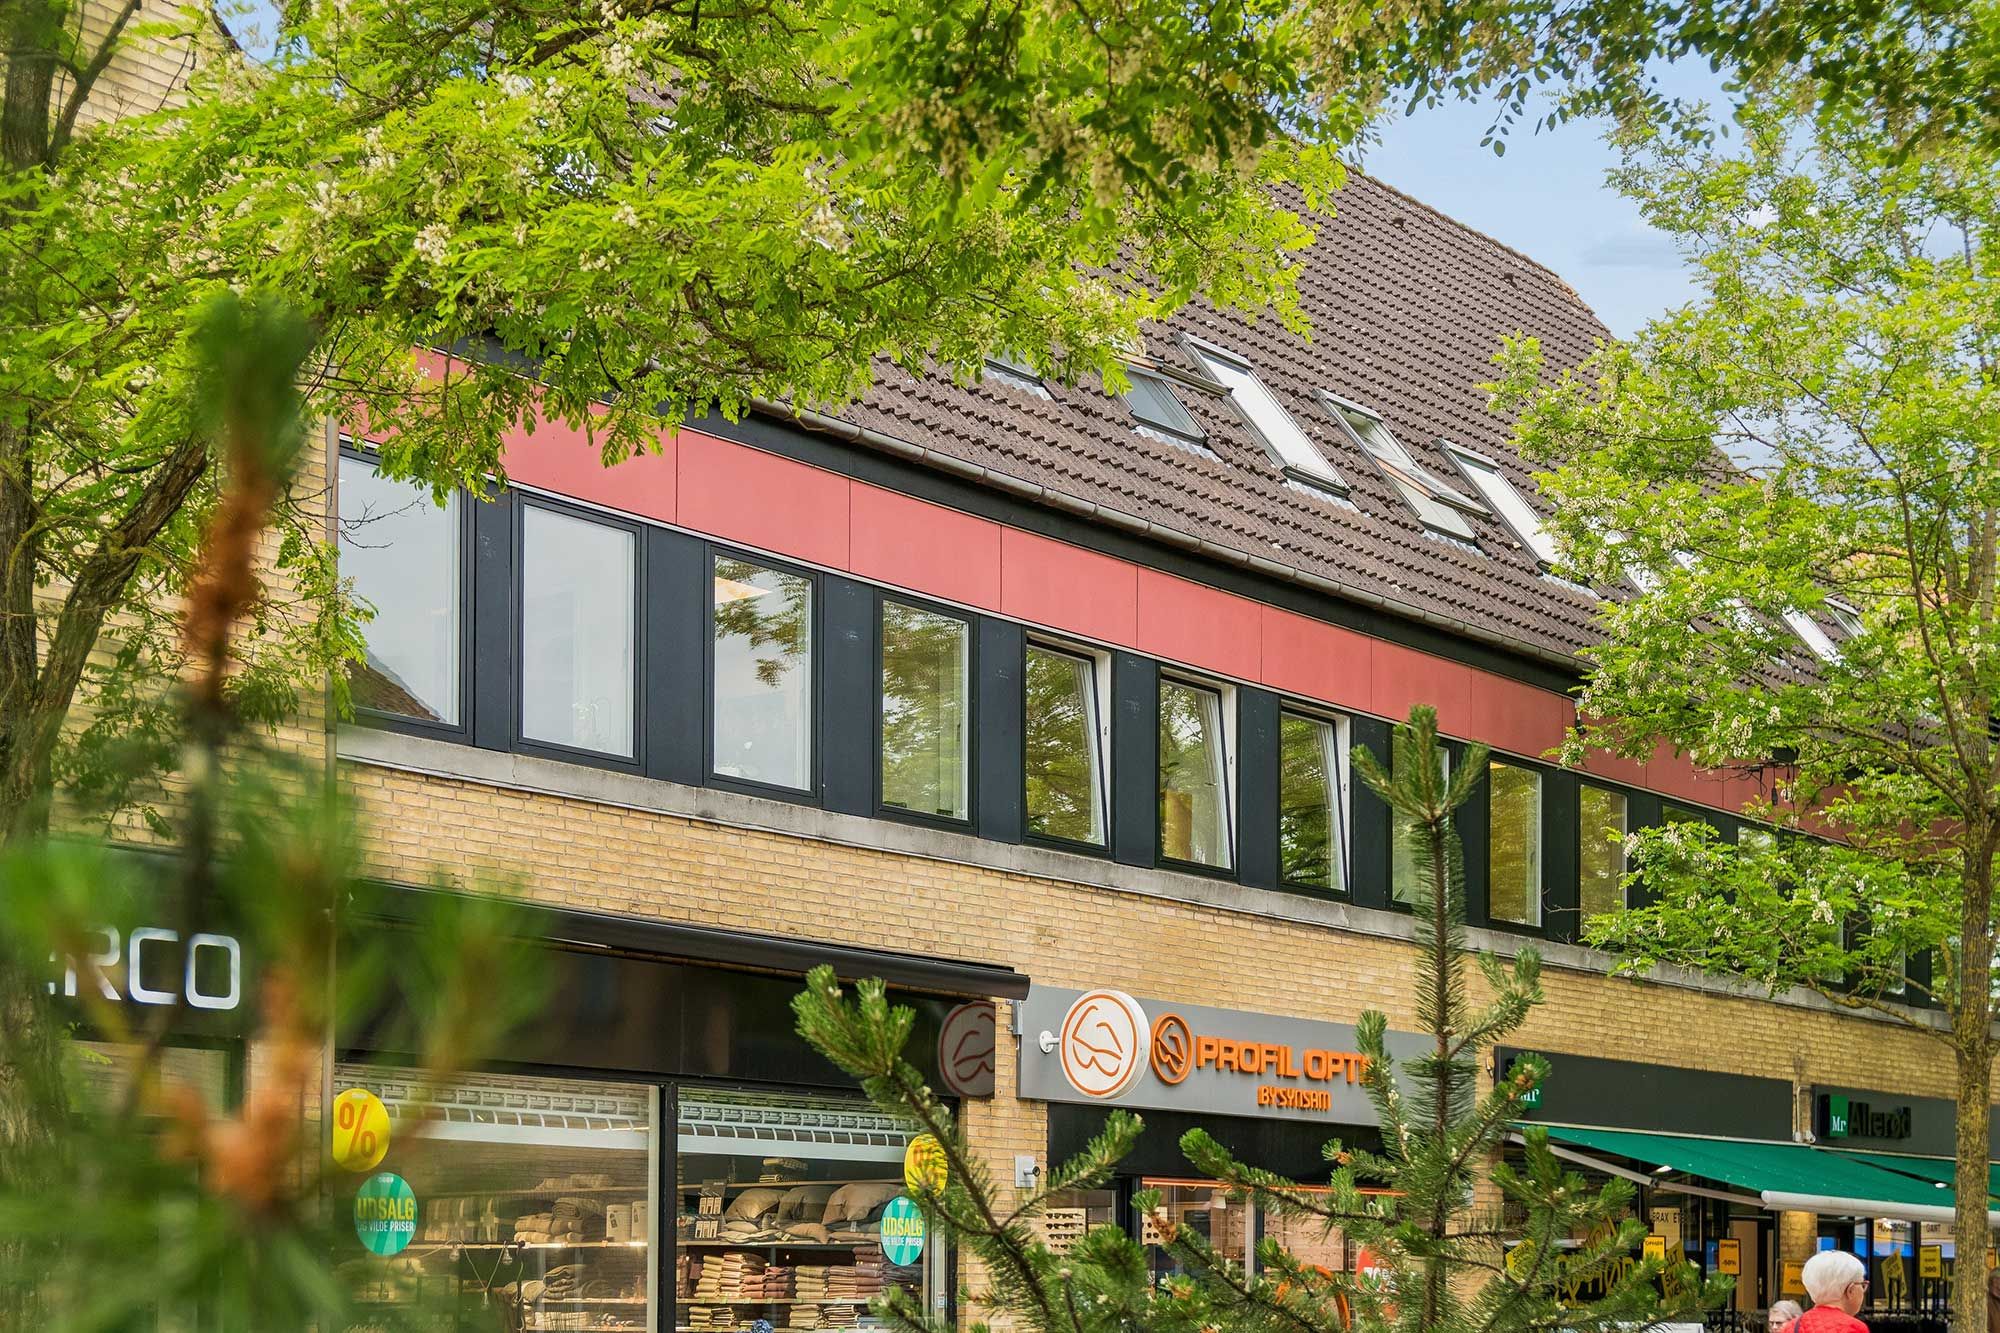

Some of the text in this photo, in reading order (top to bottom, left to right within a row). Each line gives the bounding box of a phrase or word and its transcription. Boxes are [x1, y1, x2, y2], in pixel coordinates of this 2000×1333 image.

[49, 926, 240, 1009] RCO
[1196, 1035, 1374, 1084] PROFIL OPTI
[1258, 1085, 1332, 1111] BY SYNSAM
[339, 1102, 377, 1158] %
[1832, 1116, 1847, 1132] Mr
[357, 1197, 414, 1220] UDSALG
[390, 1220, 415, 1232] PRISER
[883, 1217, 922, 1236] UDSALG
